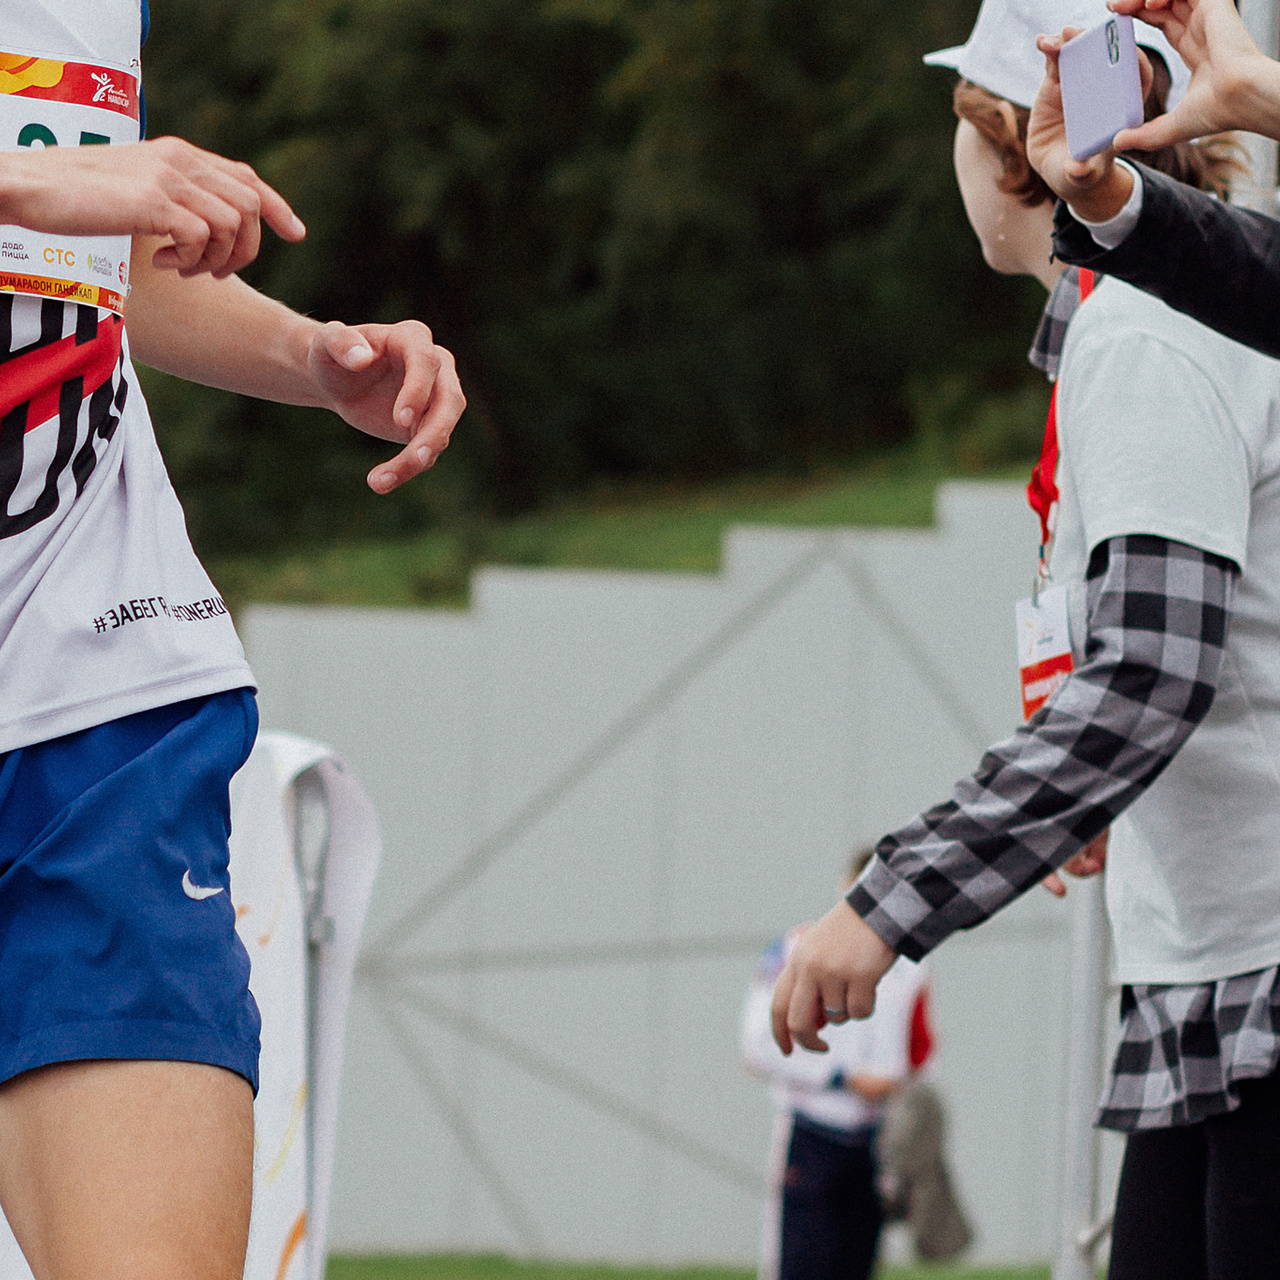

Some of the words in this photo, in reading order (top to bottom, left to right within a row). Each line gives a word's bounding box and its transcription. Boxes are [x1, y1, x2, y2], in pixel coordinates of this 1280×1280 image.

[1, 241, 25, 251] ДОДО
[1, 250, 30, 260] ПИЦЦА
[53, 282, 93, 299] ГАНДИКАП
